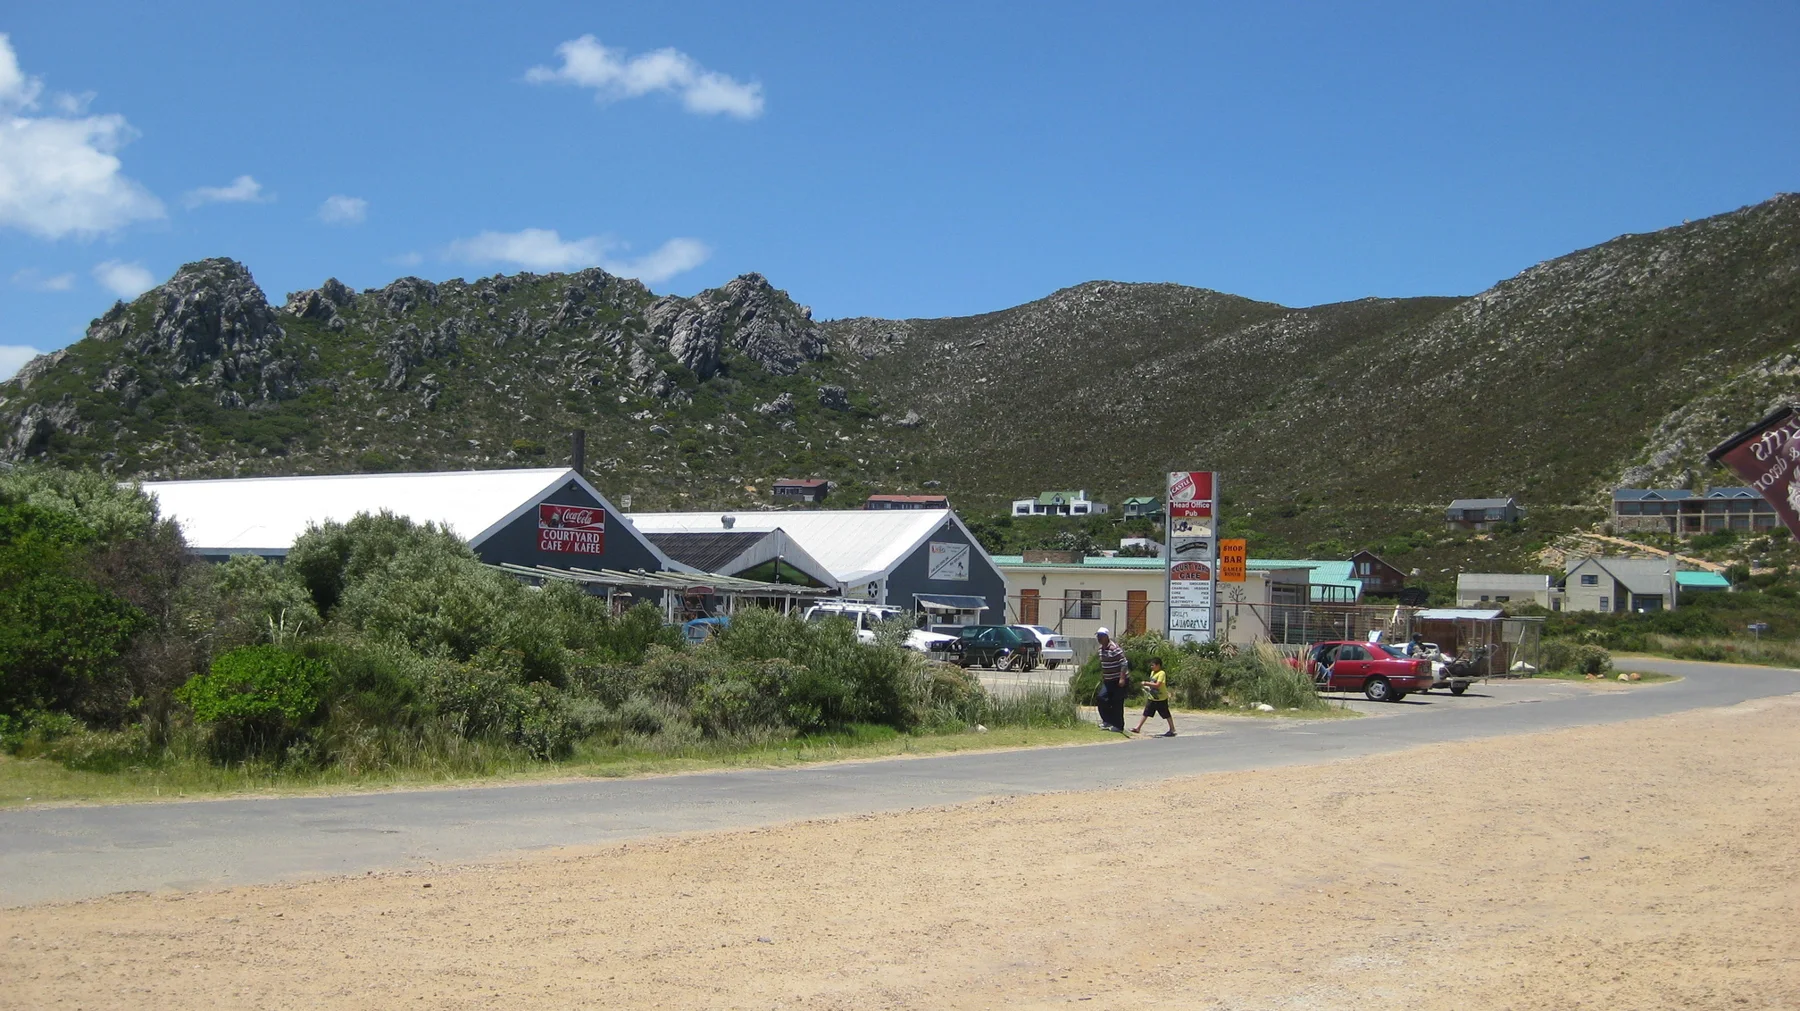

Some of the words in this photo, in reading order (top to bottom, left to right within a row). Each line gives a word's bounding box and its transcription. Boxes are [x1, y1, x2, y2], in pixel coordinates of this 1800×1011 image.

[1171, 479, 1190, 494] CASTLE
[543, 530, 600, 543] COURTYARD
[541, 540, 562, 551] CAFE
[574, 542, 601, 554] KAFEE
[1179, 572, 1201, 580] CAFE
